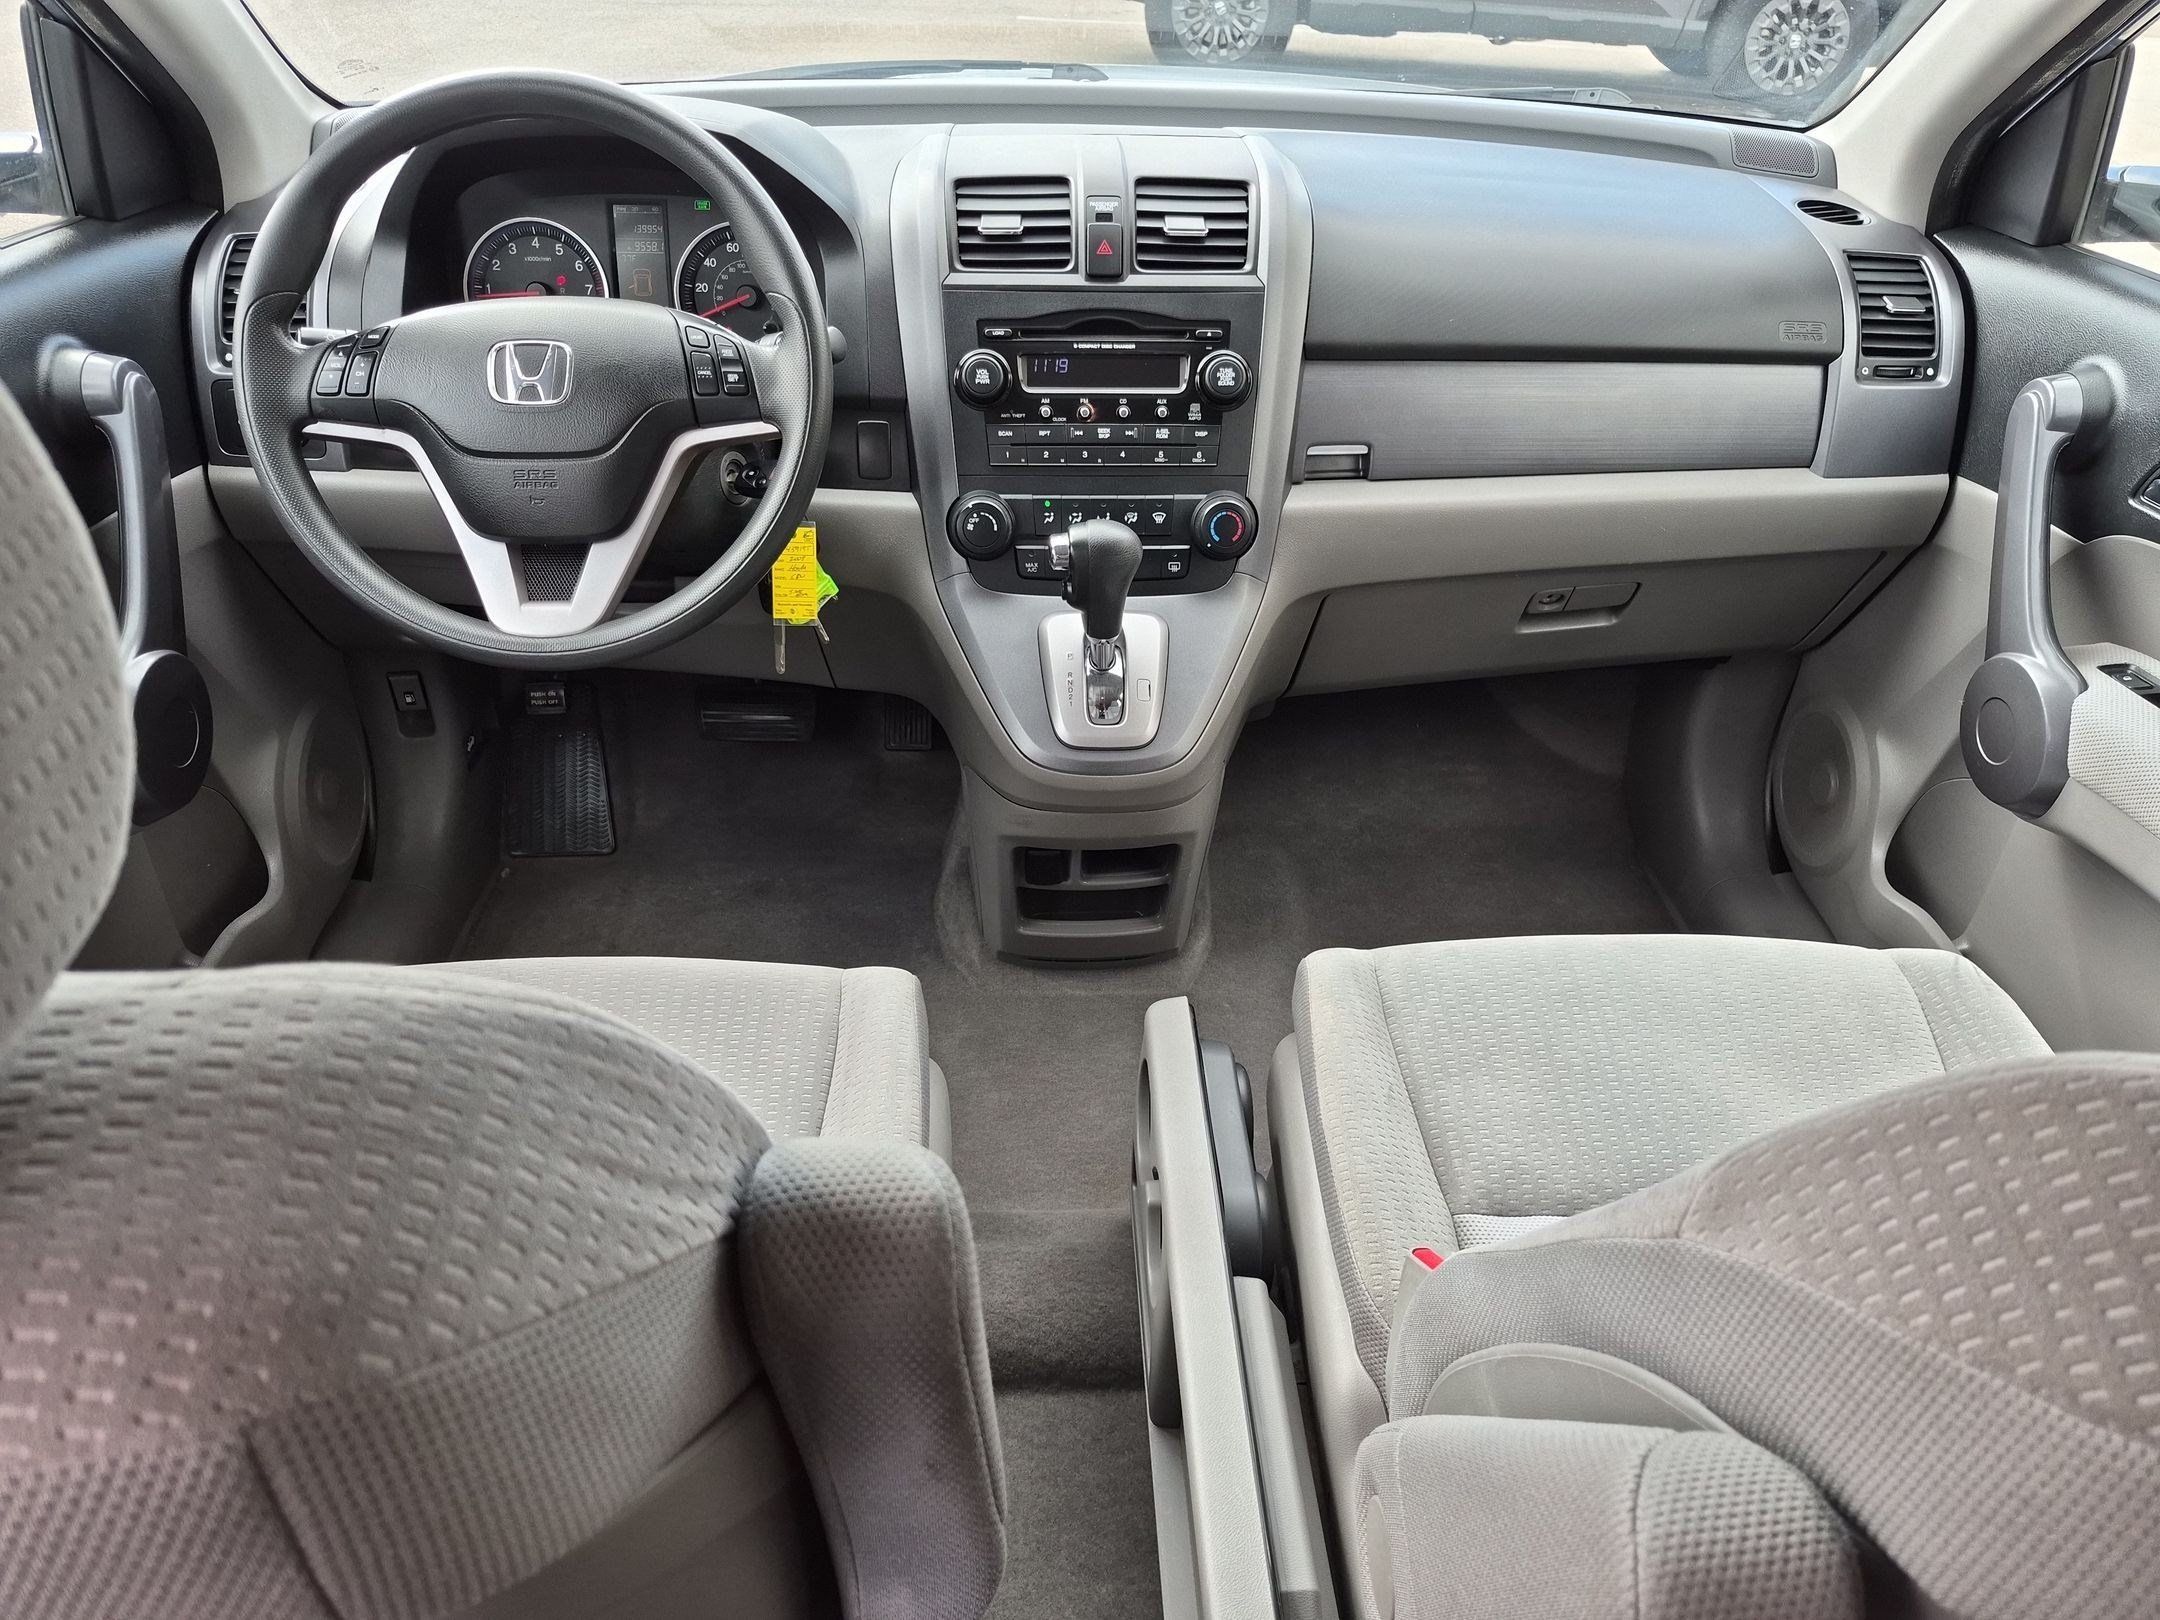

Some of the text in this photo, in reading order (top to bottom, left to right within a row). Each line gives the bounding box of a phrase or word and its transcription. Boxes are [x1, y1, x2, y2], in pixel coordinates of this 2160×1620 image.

[531, 236, 540, 249] 4
[726, 243, 739, 253] 60
[508, 243, 517, 255] 3
[555, 243, 564, 256] 5
[492, 259, 501, 271] 2
[575, 260, 584, 272] 6
[703, 257, 717, 268] 40
[486, 283, 491, 295] 1
[584, 284, 593, 296] 7
[695, 282, 709, 293] 20
[1783, 323, 1822, 332] SRS
[1120, 450, 1126, 458] 4
[1158, 450, 1164, 458] 5
[513, 469, 557, 479] SRS
[513, 481, 559, 489] AIRBAG
